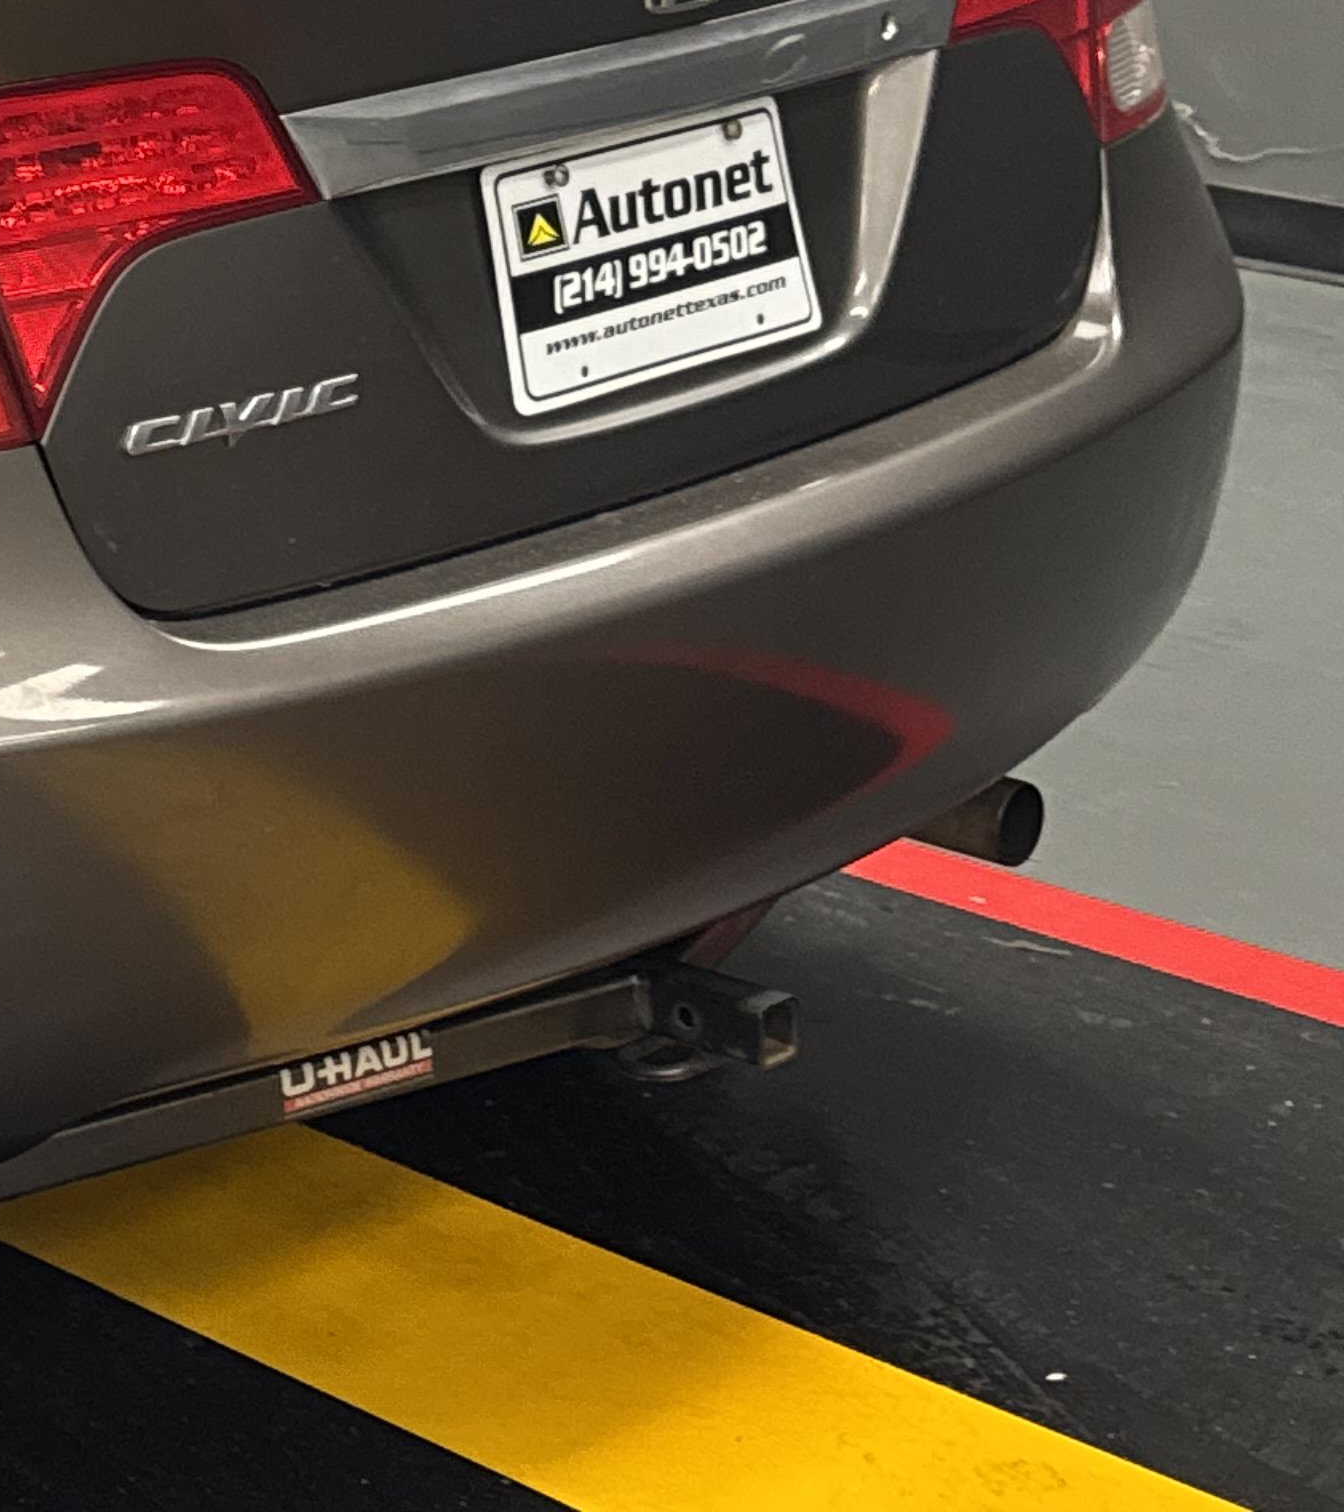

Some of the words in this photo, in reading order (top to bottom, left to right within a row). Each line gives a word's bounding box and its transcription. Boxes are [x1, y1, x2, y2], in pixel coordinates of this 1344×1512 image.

[573, 149, 774, 245] Autonet
[553, 258, 624, 316] (214)
[629, 220, 768, 290] 994-0502
[546, 275, 787, 356] www.autonettexas.com
[124, 372, 359, 457] CIVIC
[280, 1031, 433, 1097] U-HAUL
